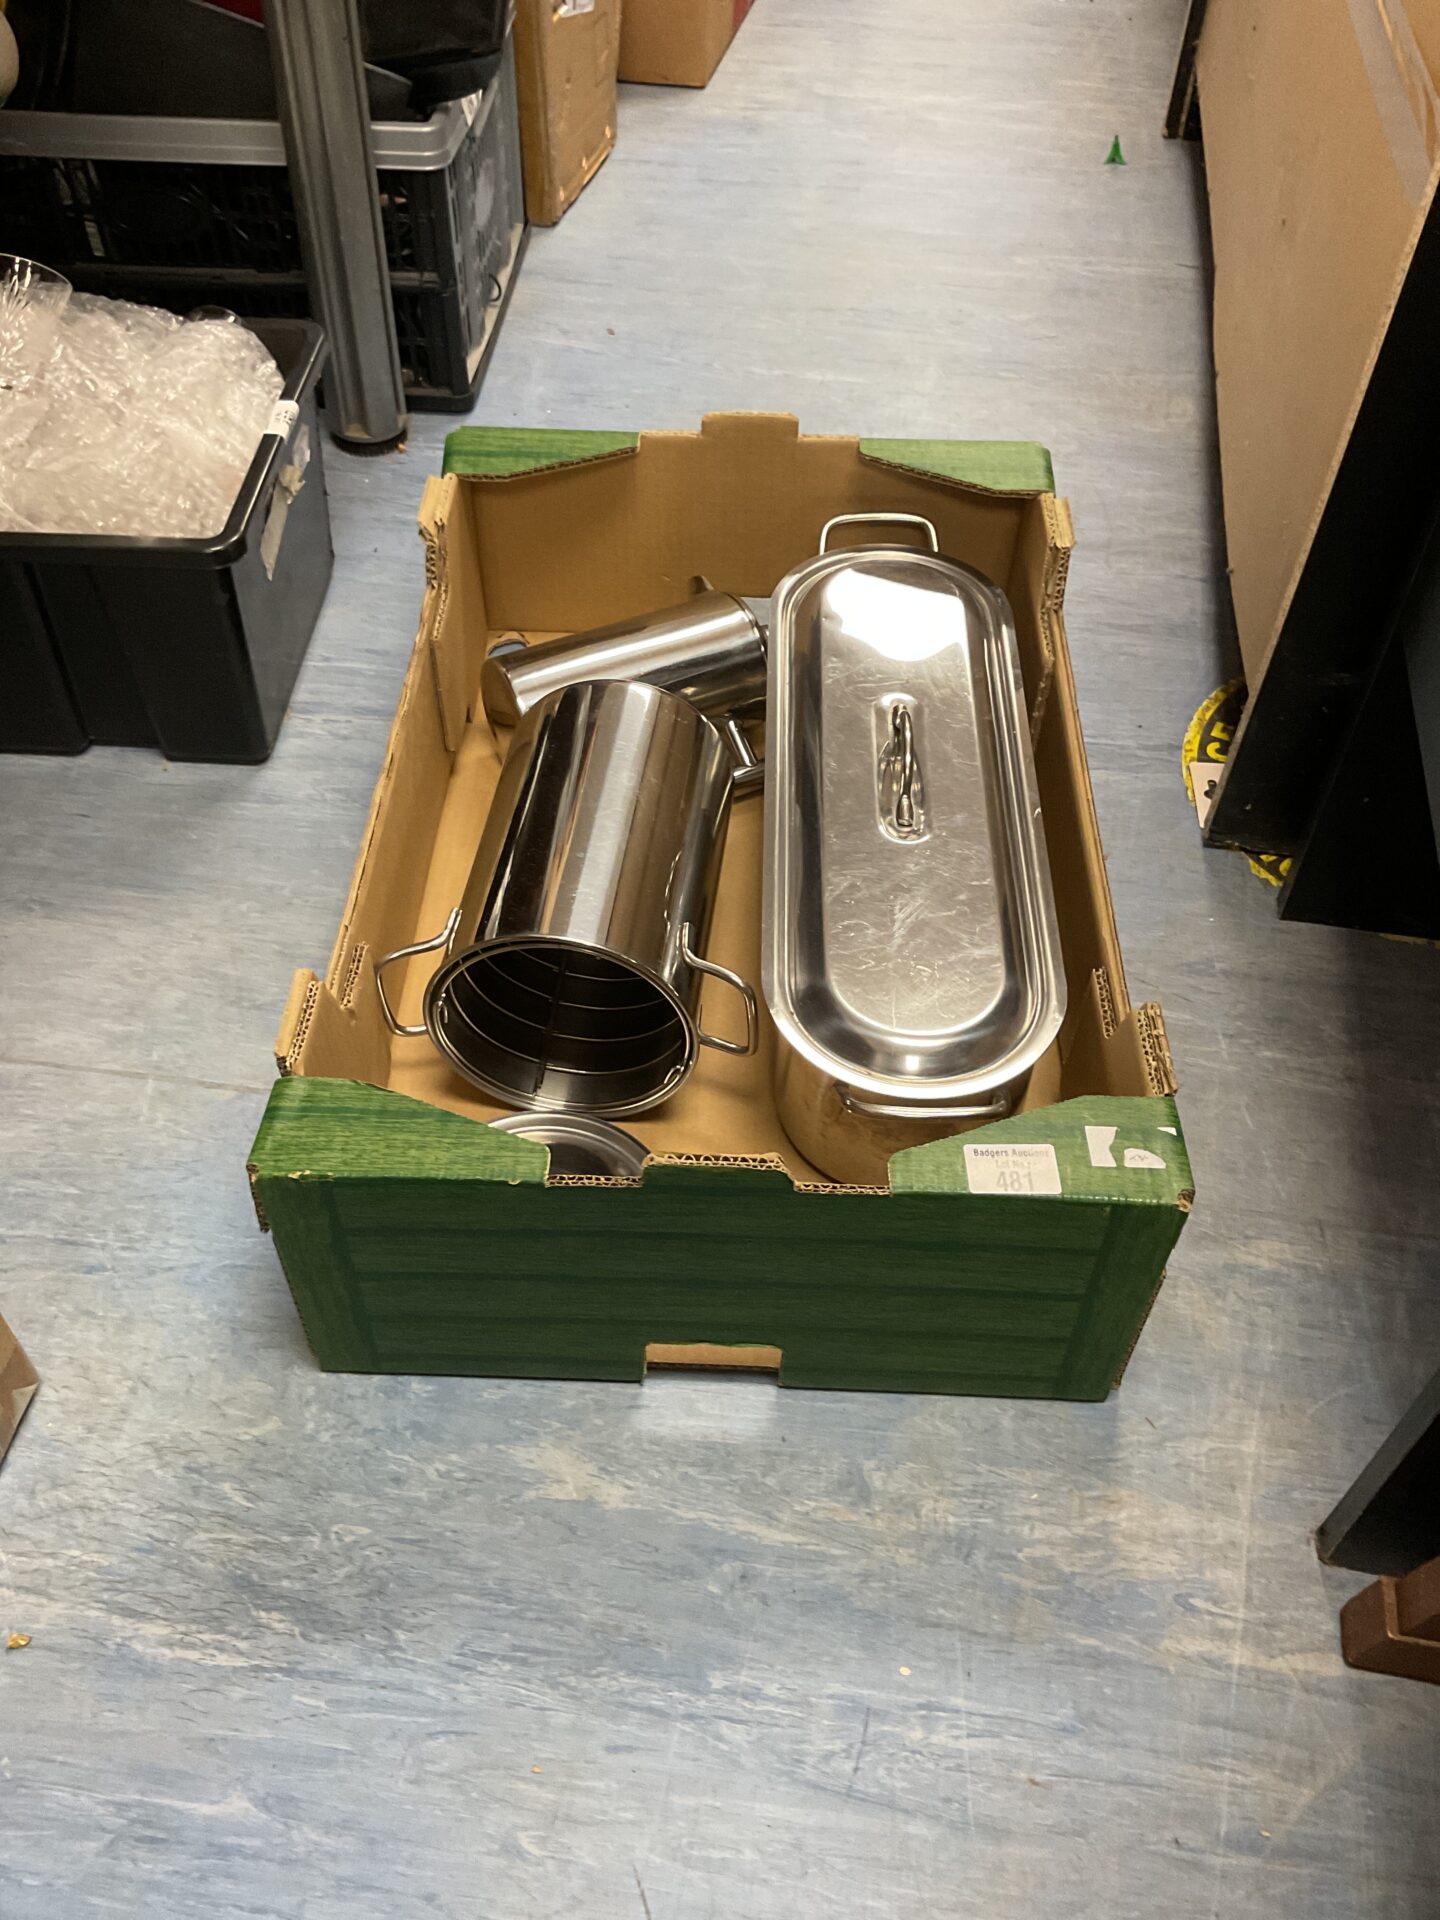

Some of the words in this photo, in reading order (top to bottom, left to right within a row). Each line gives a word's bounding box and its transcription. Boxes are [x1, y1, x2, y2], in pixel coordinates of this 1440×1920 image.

[973, 1148, 1008, 1158] Badgers
[1011, 1148, 1049, 1158] Auctions
[995, 1170, 1035, 1192] 481
